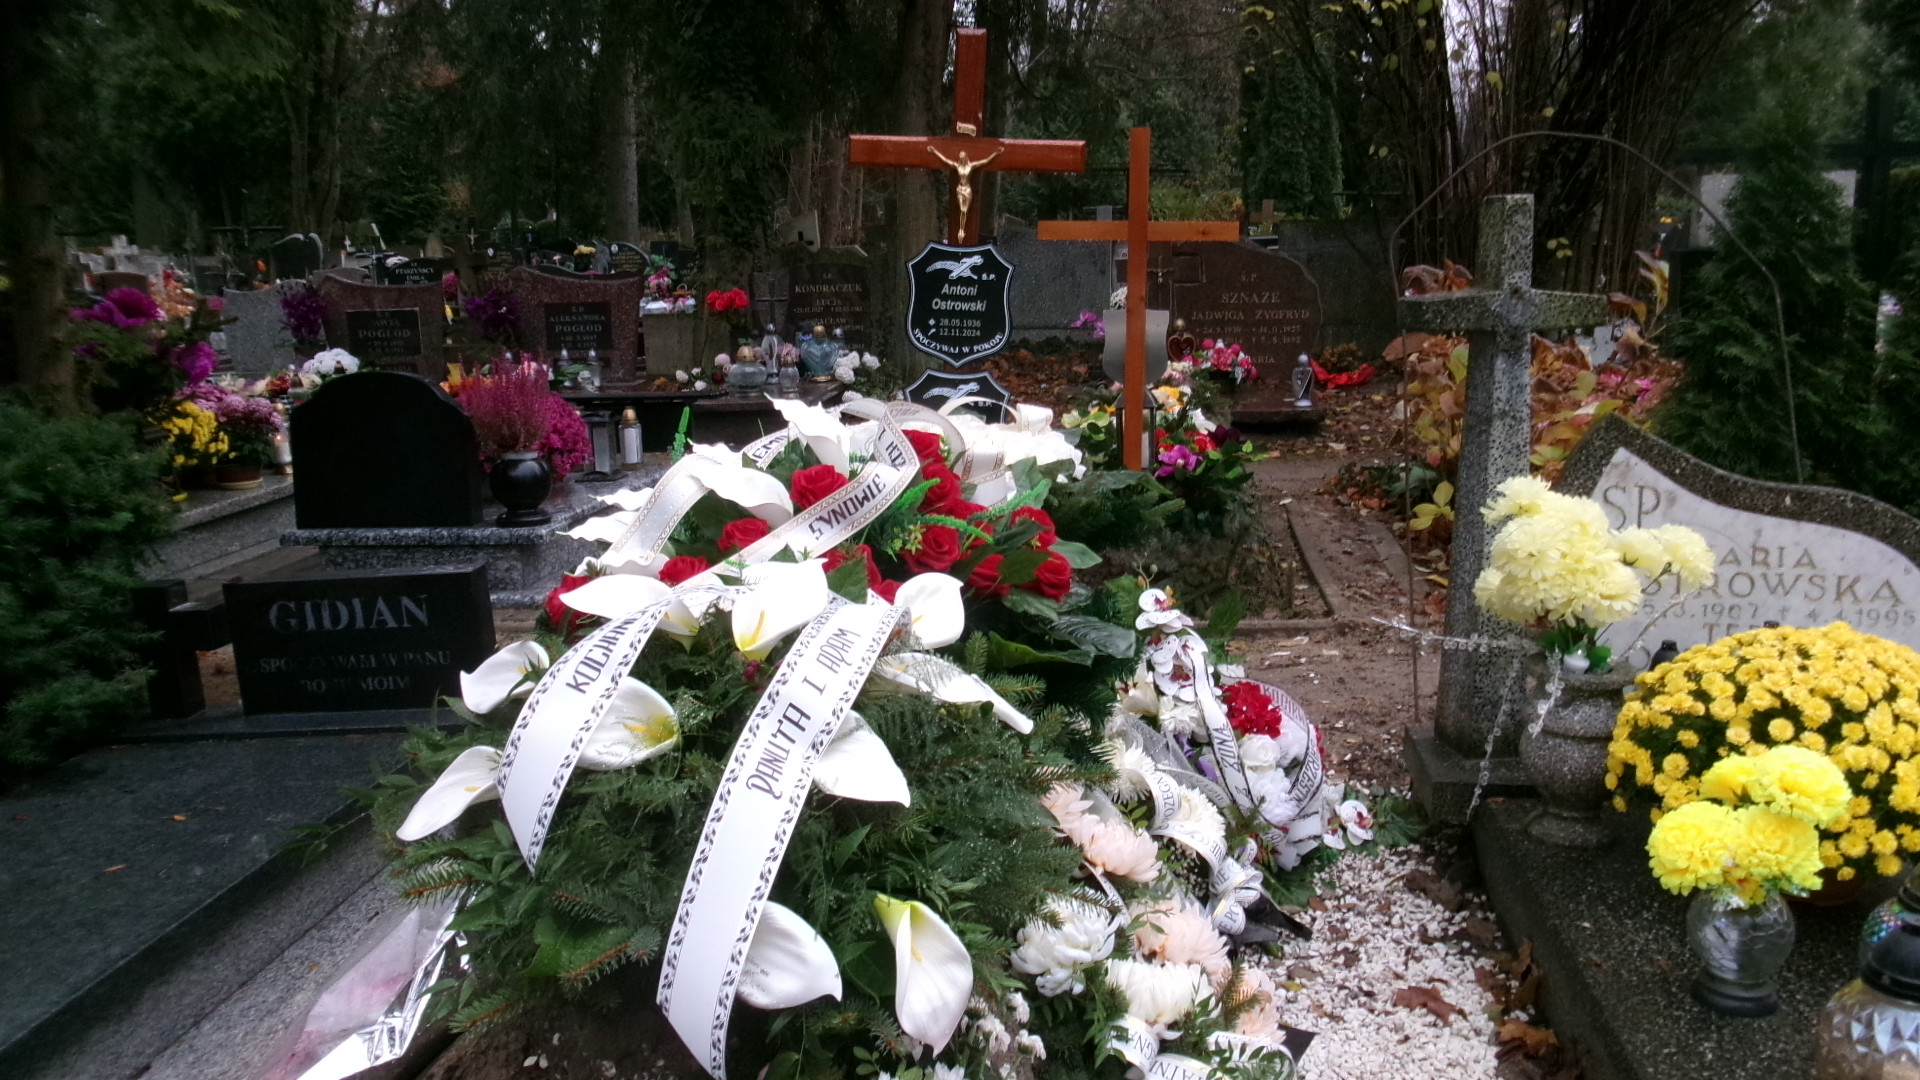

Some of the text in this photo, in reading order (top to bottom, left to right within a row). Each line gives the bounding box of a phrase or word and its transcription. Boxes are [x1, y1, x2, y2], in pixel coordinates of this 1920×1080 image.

[940, 282, 979, 297] Antoni
[931, 297, 988, 312] Ostrowski
[549, 313, 606, 322] ALEKSANDRA
[1191, 309, 1310, 321] JADWIGA ZYGFRYD
[939, 318, 982, 328] 28.05.1936
[939, 328, 981, 337] 12.11.2024
[912, 327, 1005, 354] SPOCZYWAJ W POKOJU
[808, 473, 887, 541] SYNOWIE
[1712, 543, 1818, 570] ARIA
[745, 702, 813, 801] DANUTA
[817, 627, 863, 678] ADAM
